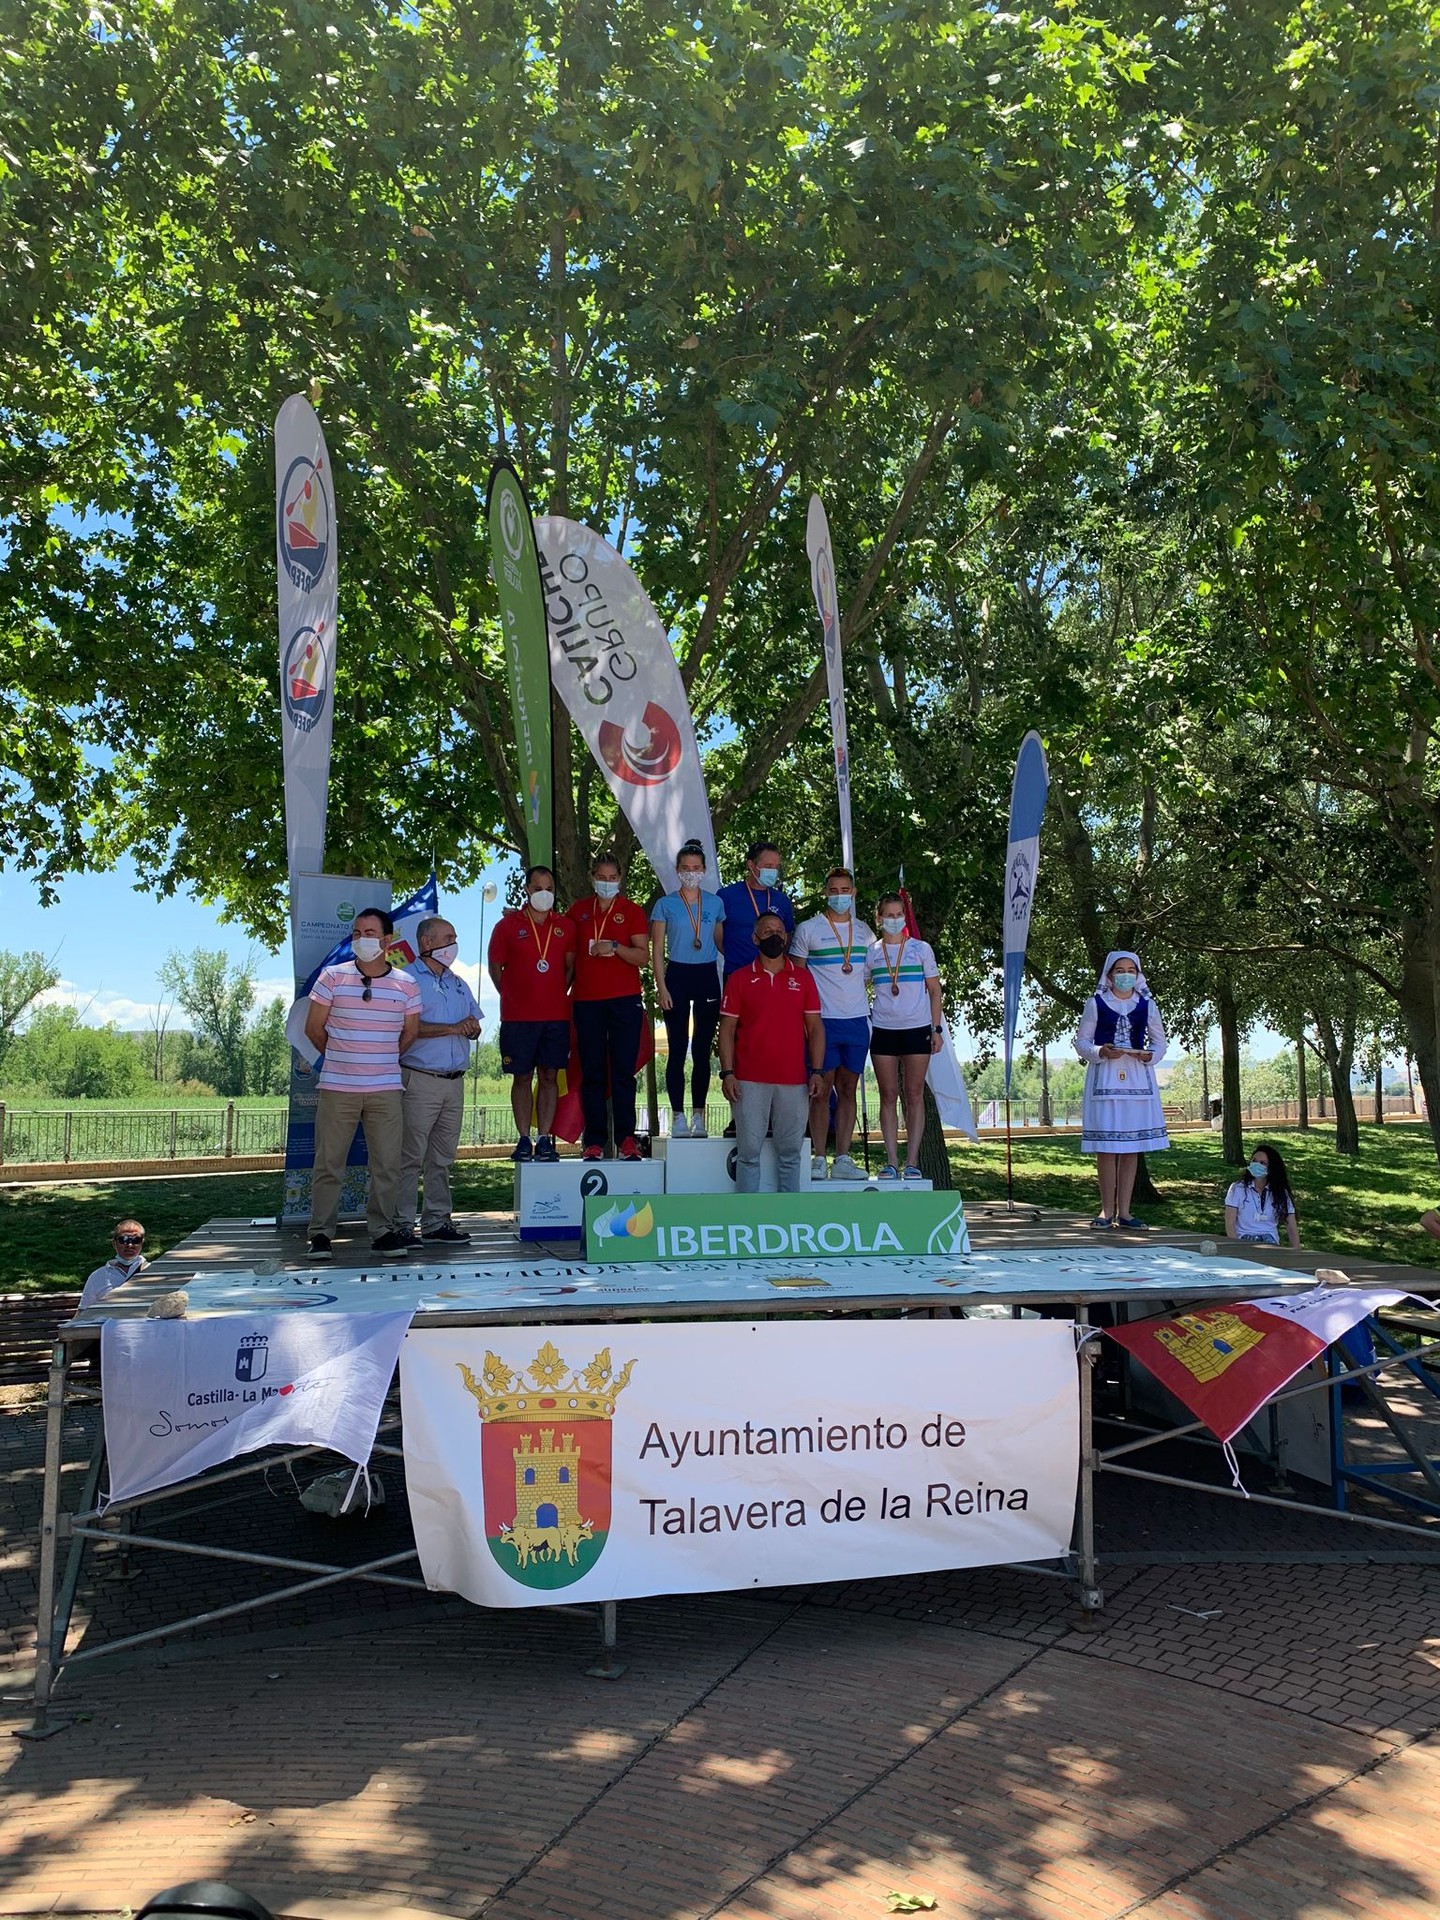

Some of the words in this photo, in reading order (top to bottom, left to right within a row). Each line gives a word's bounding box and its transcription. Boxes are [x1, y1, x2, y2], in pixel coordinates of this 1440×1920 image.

[301, 920, 350, 931] CAMPEONATO
[587, 1175, 603, 1196] 2
[656, 1222, 904, 1257] IBERDROLA
[242, 1389, 257, 1403] La
[639, 1416, 908, 1468] Ayuntamiento
[921, 1414, 966, 1448] de
[639, 1497, 807, 1536] Talavera
[820, 1489, 866, 1524] de
[880, 1487, 912, 1521] la
[926, 1481, 1029, 1519] Reina
